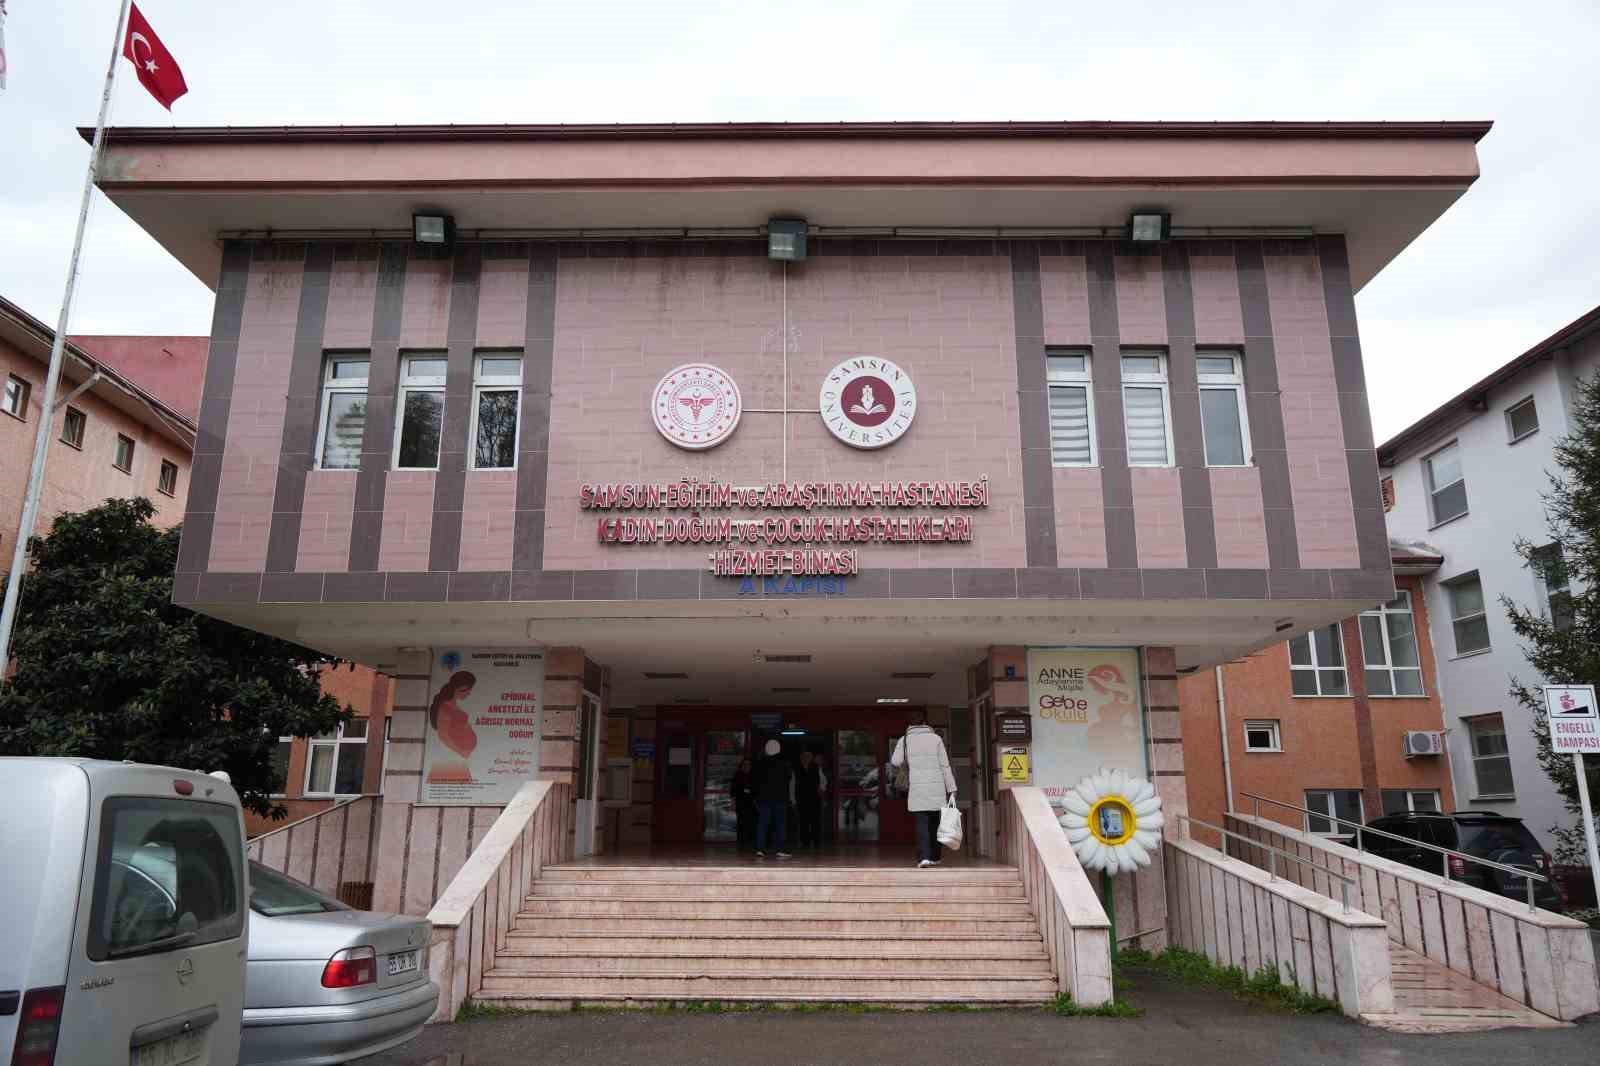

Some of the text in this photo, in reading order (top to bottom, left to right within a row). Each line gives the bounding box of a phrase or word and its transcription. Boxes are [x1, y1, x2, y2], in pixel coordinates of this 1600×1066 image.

[831, 359, 903, 383] SAMSUN
[579, 472, 989, 510] SAMSUN EĞİTİM ve ARAŞTIRMA HASTANESİ
[597, 511, 972, 545] KADIN DOĞUM ve ÇOCUK HASTALIKLARI
[713, 543, 857, 576] HİZMET BİNASI
[738, 576, 757, 593] A
[1039, 667, 1084, 679] ANNE
[1040, 694, 1088, 710] Gebe
